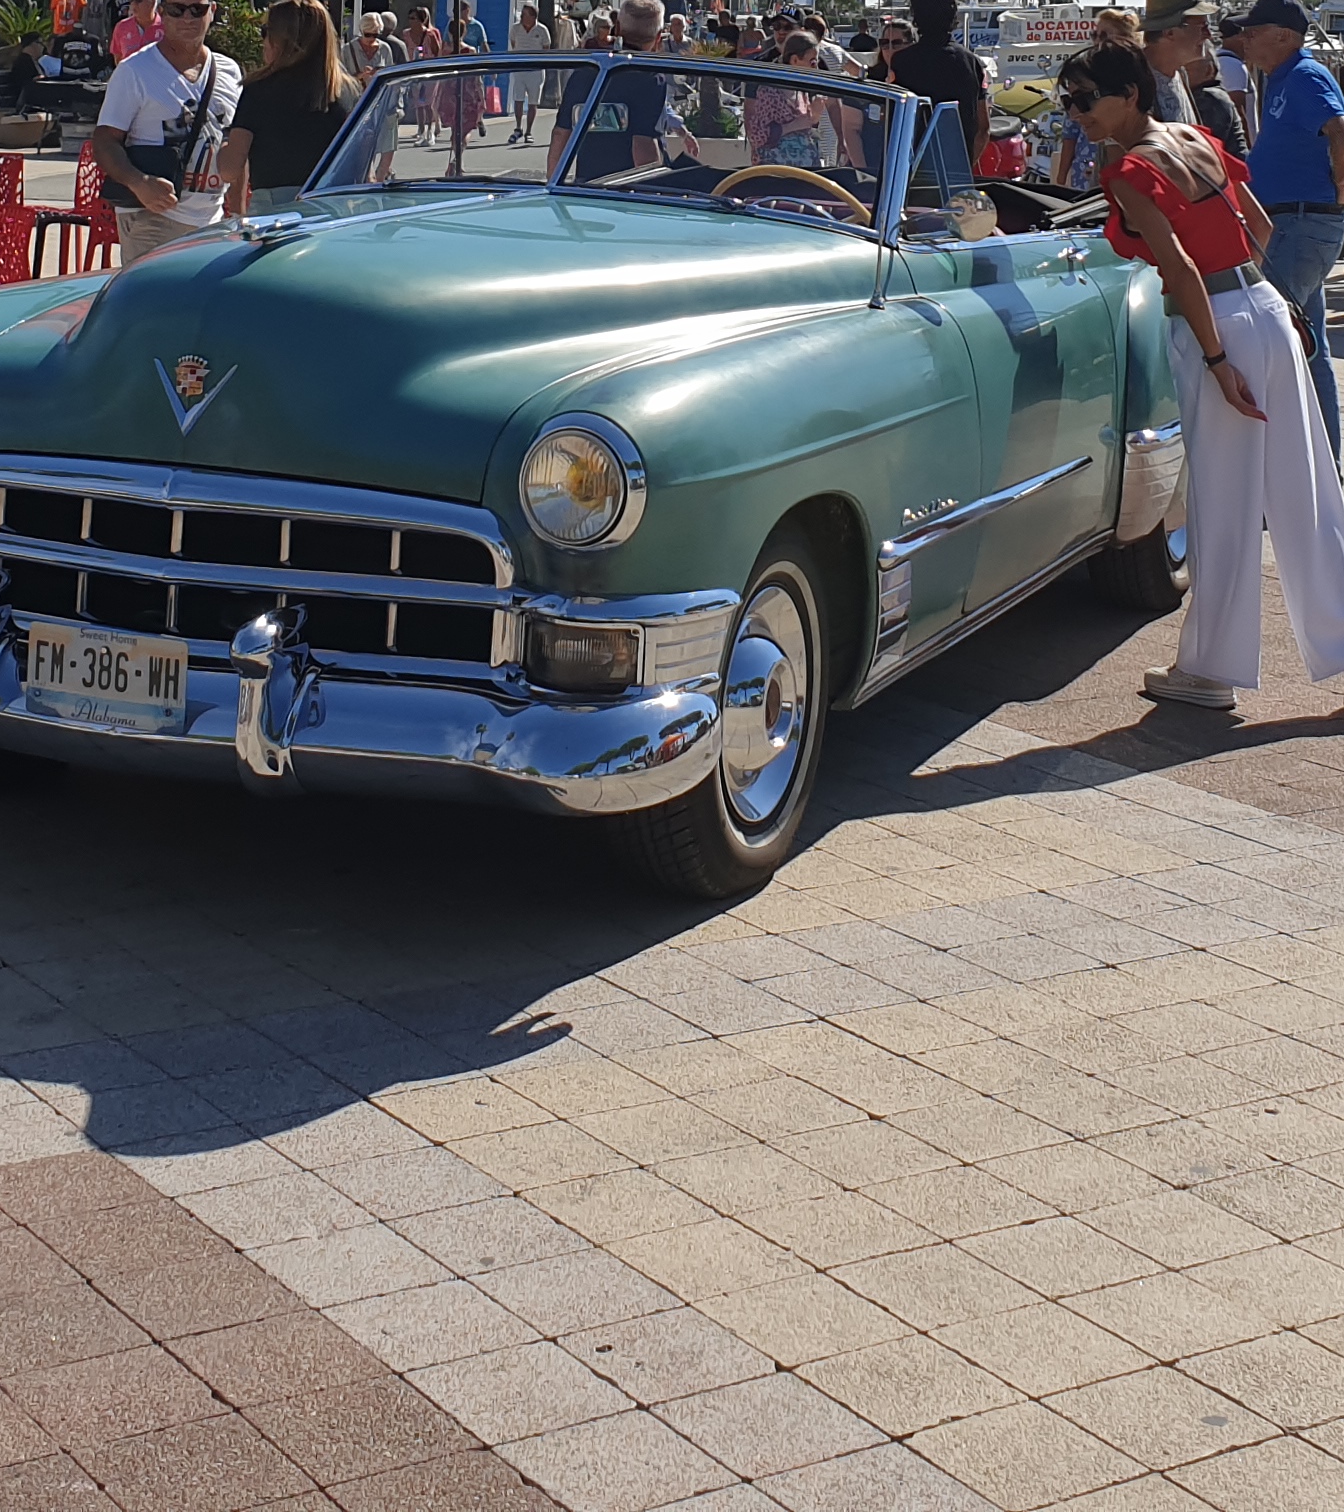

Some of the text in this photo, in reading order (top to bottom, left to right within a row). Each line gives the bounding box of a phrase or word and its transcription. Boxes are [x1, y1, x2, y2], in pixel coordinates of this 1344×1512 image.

[1026, 31, 1091, 41] de BATEAU
[1007, 54, 1035, 62] avec
[79, 628, 138, 646] Sweet Home
[70, 698, 137, 727] Alabama
